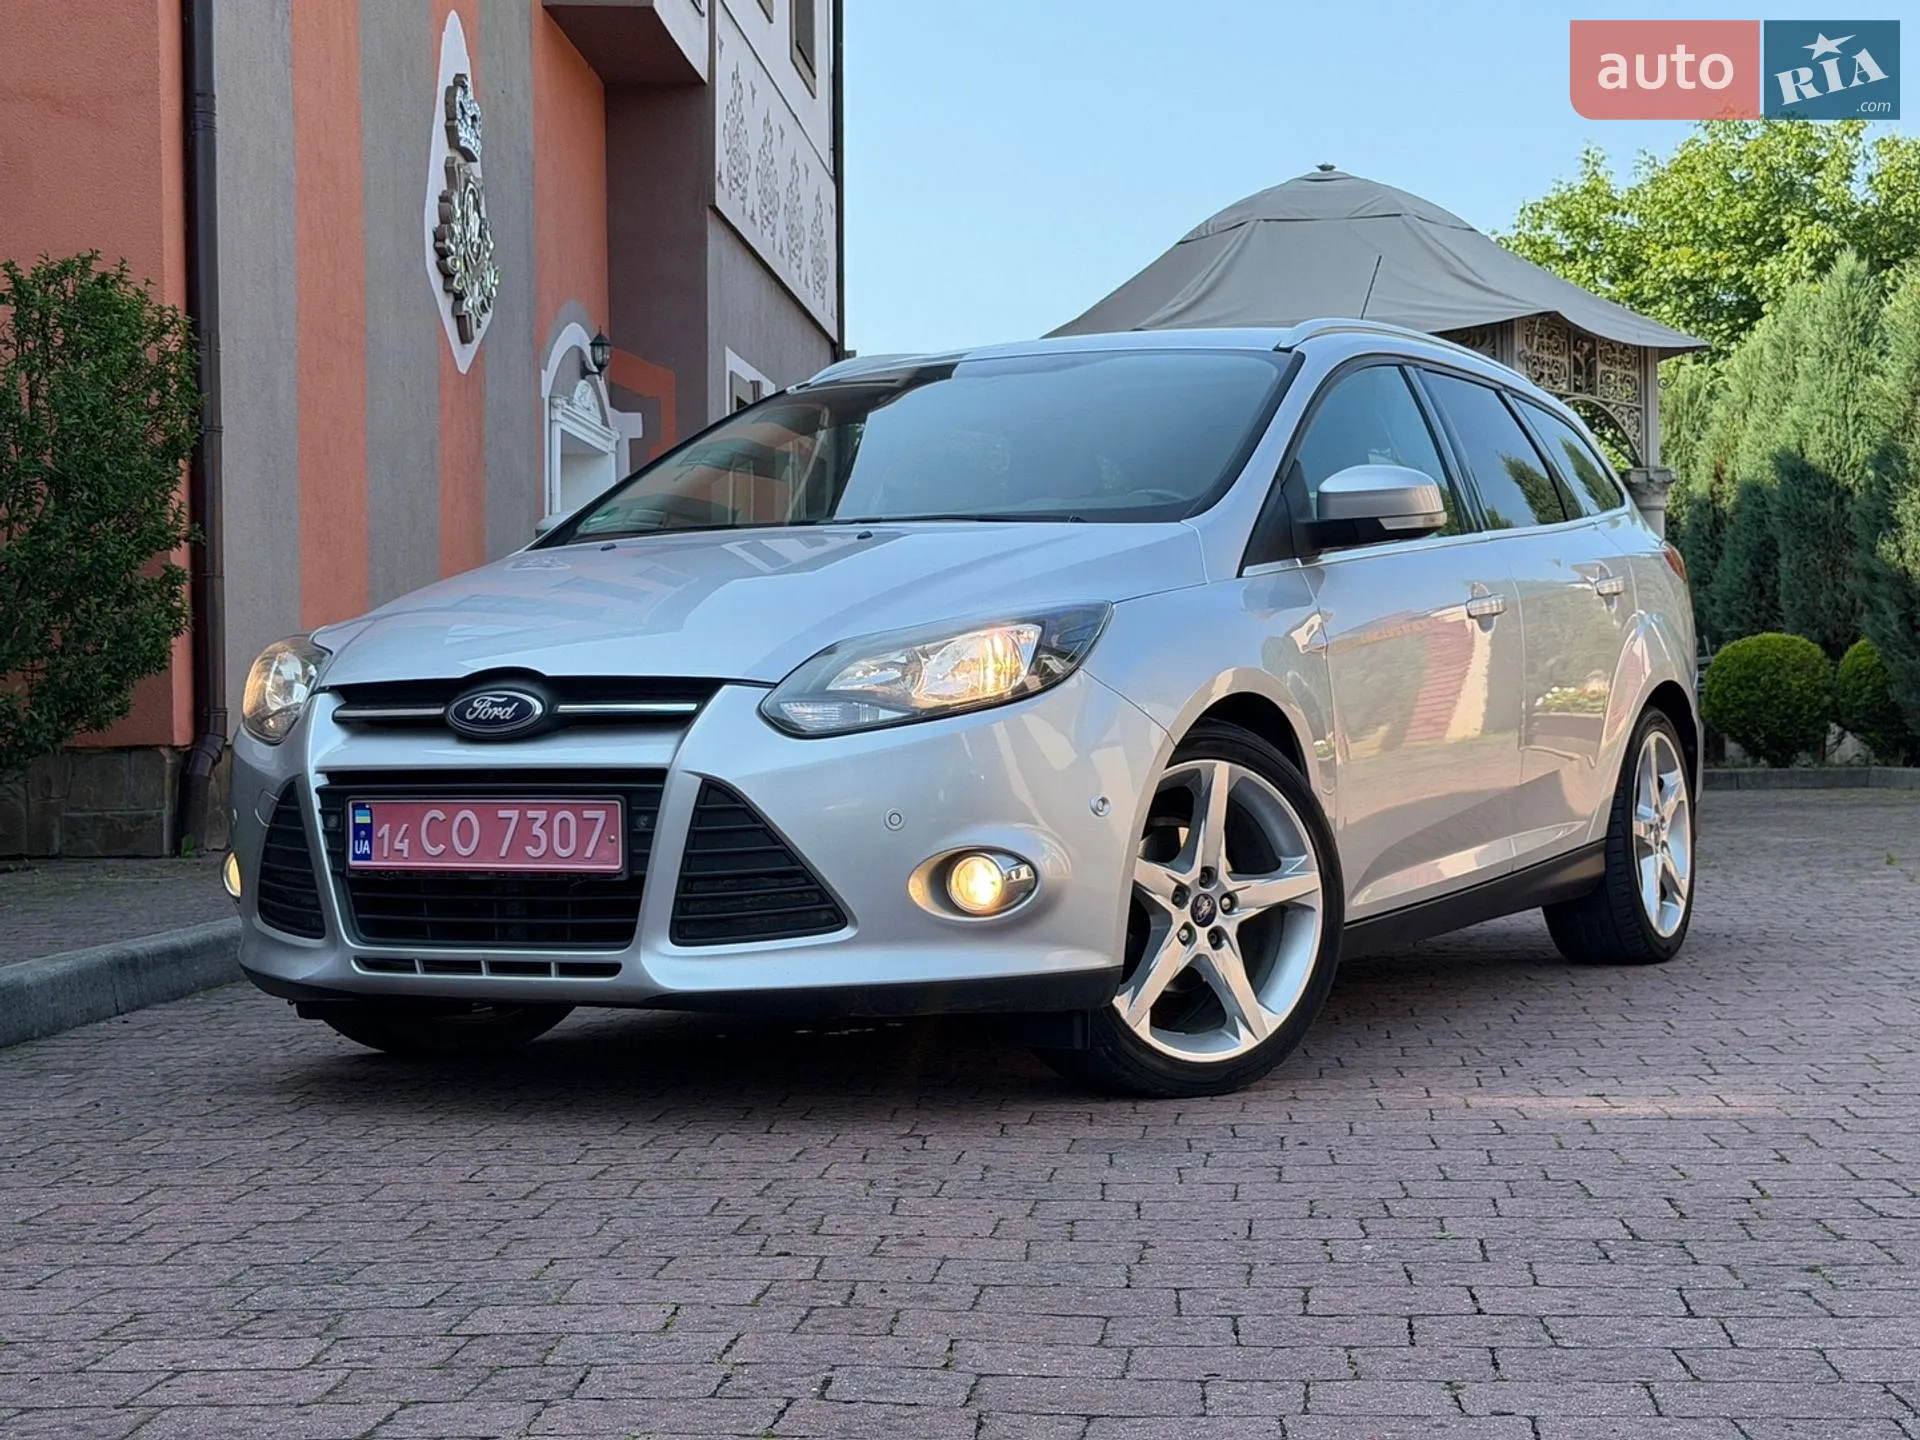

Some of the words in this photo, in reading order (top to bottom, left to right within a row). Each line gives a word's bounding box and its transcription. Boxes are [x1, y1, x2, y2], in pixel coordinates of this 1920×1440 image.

[465, 695, 519, 720] Ford
[377, 823, 409, 858] 14
[497, 810, 606, 858] 7307
[354, 839, 371, 855] UA
